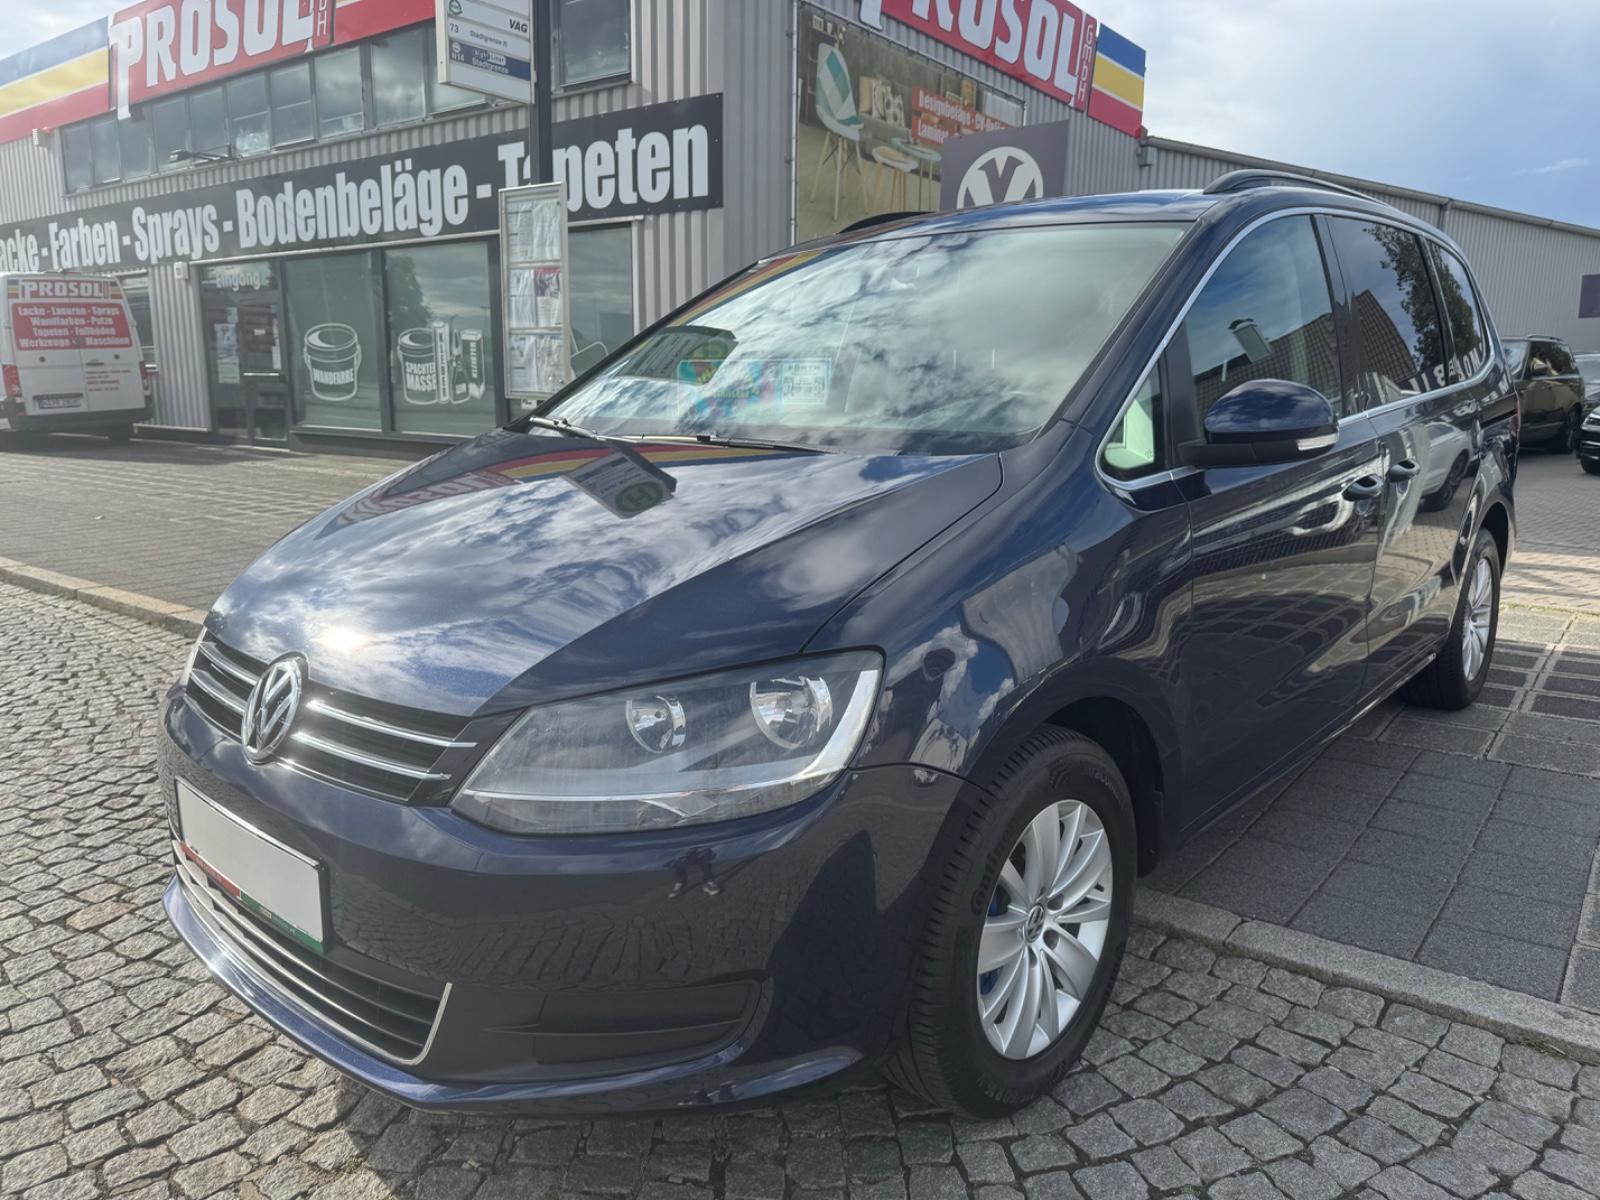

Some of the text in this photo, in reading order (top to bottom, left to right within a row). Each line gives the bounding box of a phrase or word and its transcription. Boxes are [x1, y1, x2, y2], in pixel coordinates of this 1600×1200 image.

[449, 23, 460, 33] 73
[509, 19, 528, 33] VAG
[48, 217, 121, 271] Farben
[131, 203, 220, 264] Sprays
[236, 158, 469, 249] Bodenbeläge
[20, 281, 104, 300] PROSOL
